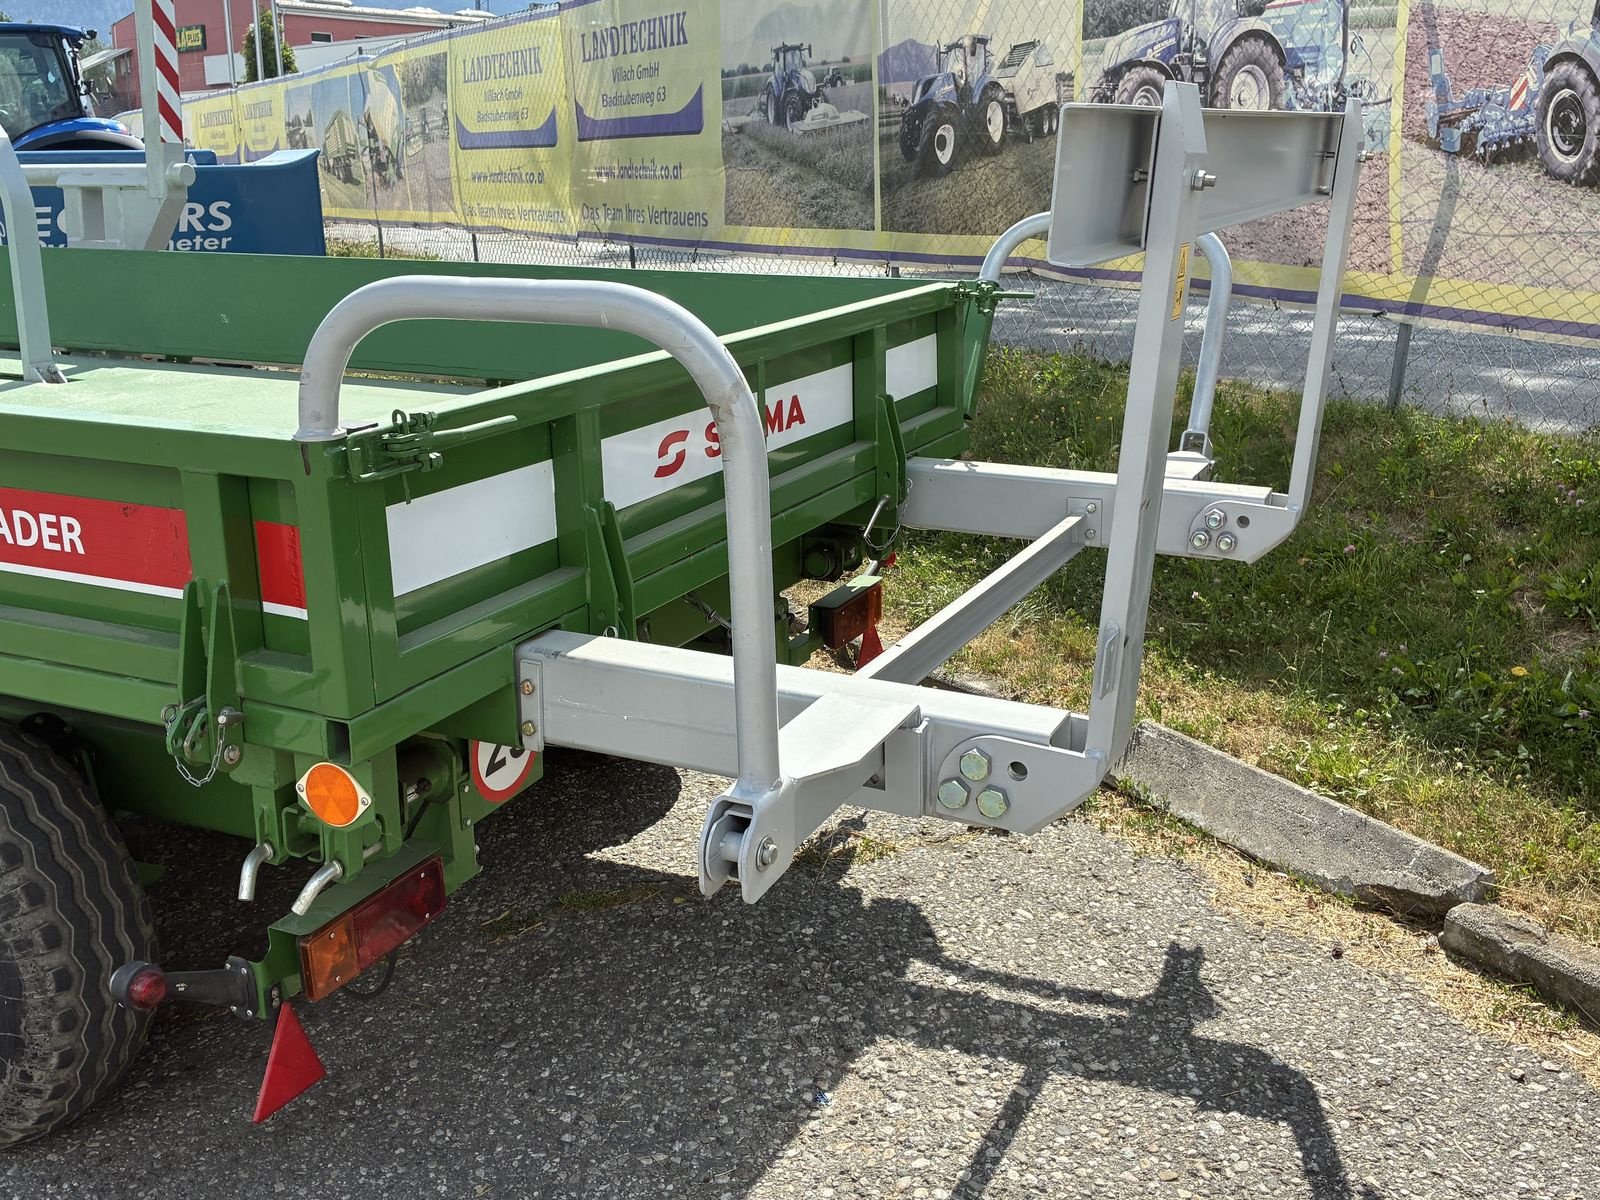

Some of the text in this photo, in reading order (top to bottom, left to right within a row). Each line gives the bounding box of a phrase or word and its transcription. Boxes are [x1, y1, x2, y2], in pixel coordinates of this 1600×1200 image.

[580, 11, 688, 63] LANDTECHNIK
[463, 46, 543, 84] LANDTECHNIK
[612, 61, 660, 83] Villach GmbH
[505, 87, 523, 101] GmbH
[601, 86, 667, 108] Badstubenweg 63
[520, 107, 529, 120] 63
[517, 205, 566, 223] Vertrauens
[582, 203, 709, 227] Das Team Ihres Vertrauens
